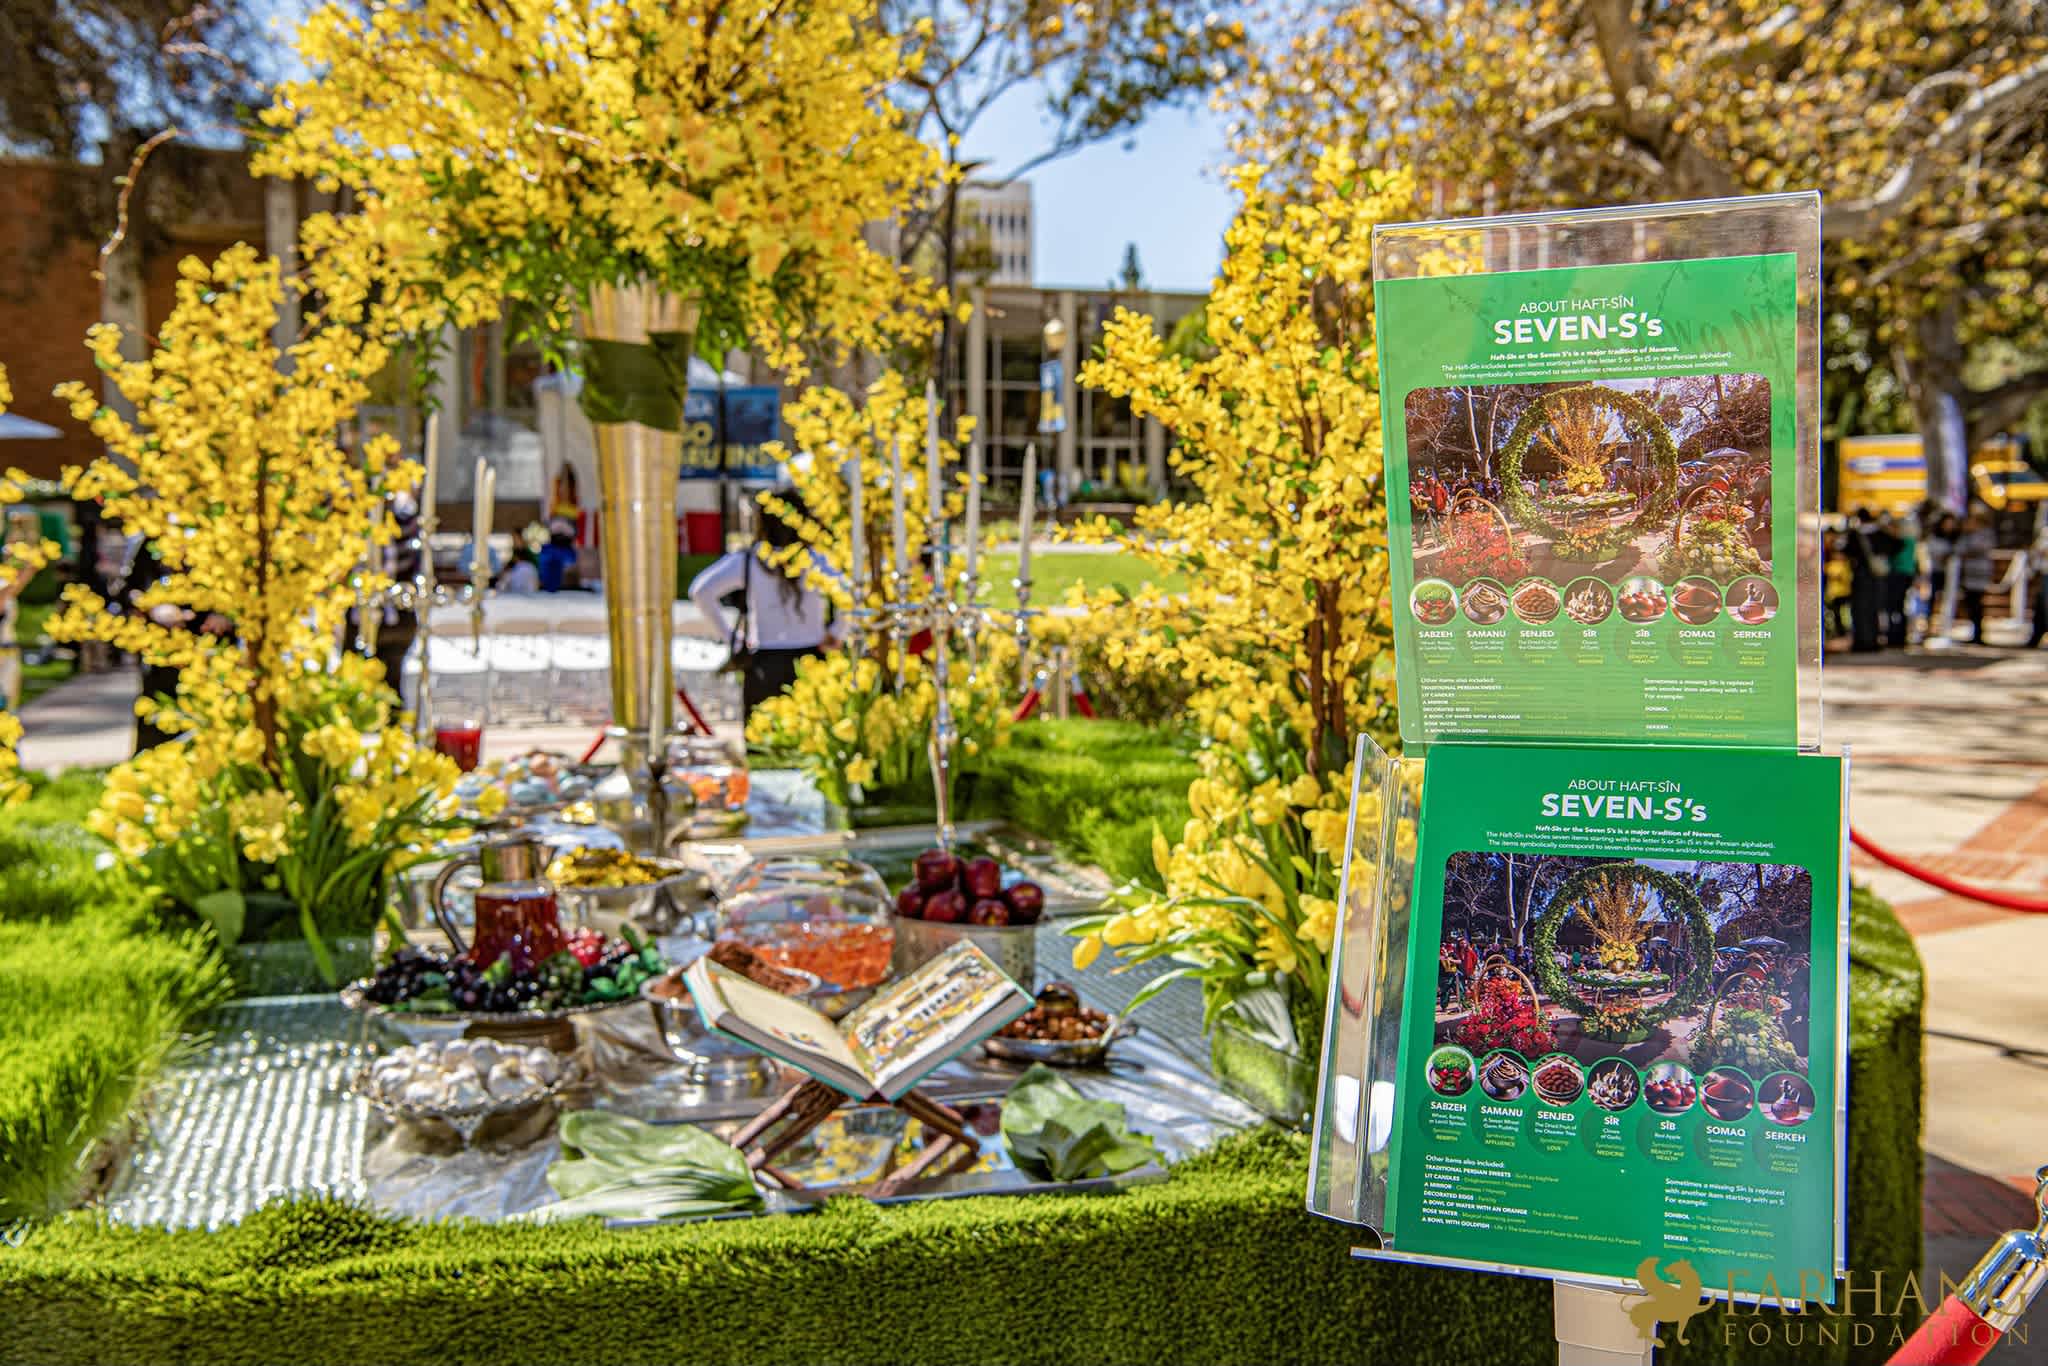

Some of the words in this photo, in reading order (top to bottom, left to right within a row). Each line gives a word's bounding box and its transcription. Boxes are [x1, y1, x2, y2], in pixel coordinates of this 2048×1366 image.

[1520, 300, 1568, 313] ABOUT
[1494, 312, 1663, 344] SEVEN-S's
[1466, 630, 1505, 638] SAMANU
[1520, 630, 1554, 638] SENJED
[1679, 630, 1715, 638] SOMAQ
[1733, 631, 1771, 639] SERKEH
[1568, 779, 1616, 791] ABOUT
[1541, 793, 1707, 822] SEVEN-S's
[1630, 829, 1649, 837] major
[1431, 1101, 1467, 1112] SABZEH
[1481, 1106, 1523, 1117] SAMANU
[1537, 1111, 1574, 1121] SENJED
[1706, 1126, 1745, 1137] SOMAQ
[1765, 1130, 1805, 1143] SERKEH
